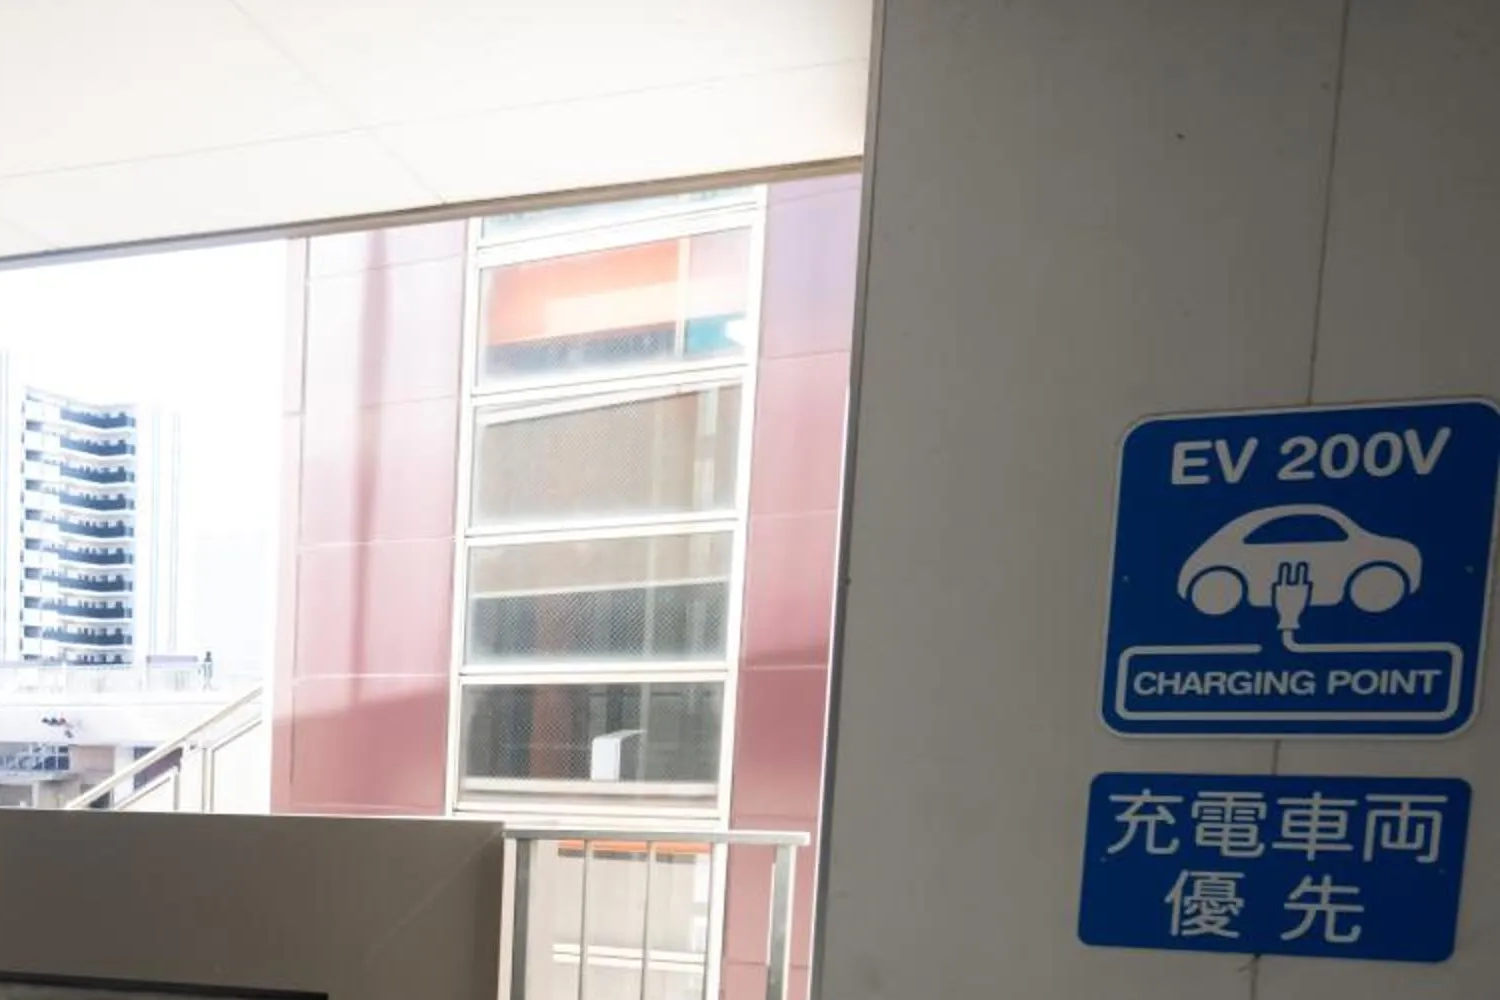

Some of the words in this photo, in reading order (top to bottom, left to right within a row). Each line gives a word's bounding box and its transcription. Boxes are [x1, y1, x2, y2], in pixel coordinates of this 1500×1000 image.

[1171, 437, 1258, 485] EV
[1277, 427, 1451, 481] 200V
[1133, 670, 1315, 696] CHARGING
[1328, 669, 1441, 695] POINT
[1107, 789, 1448, 863] 充電車両
[1165, 868, 1364, 943] 優先
